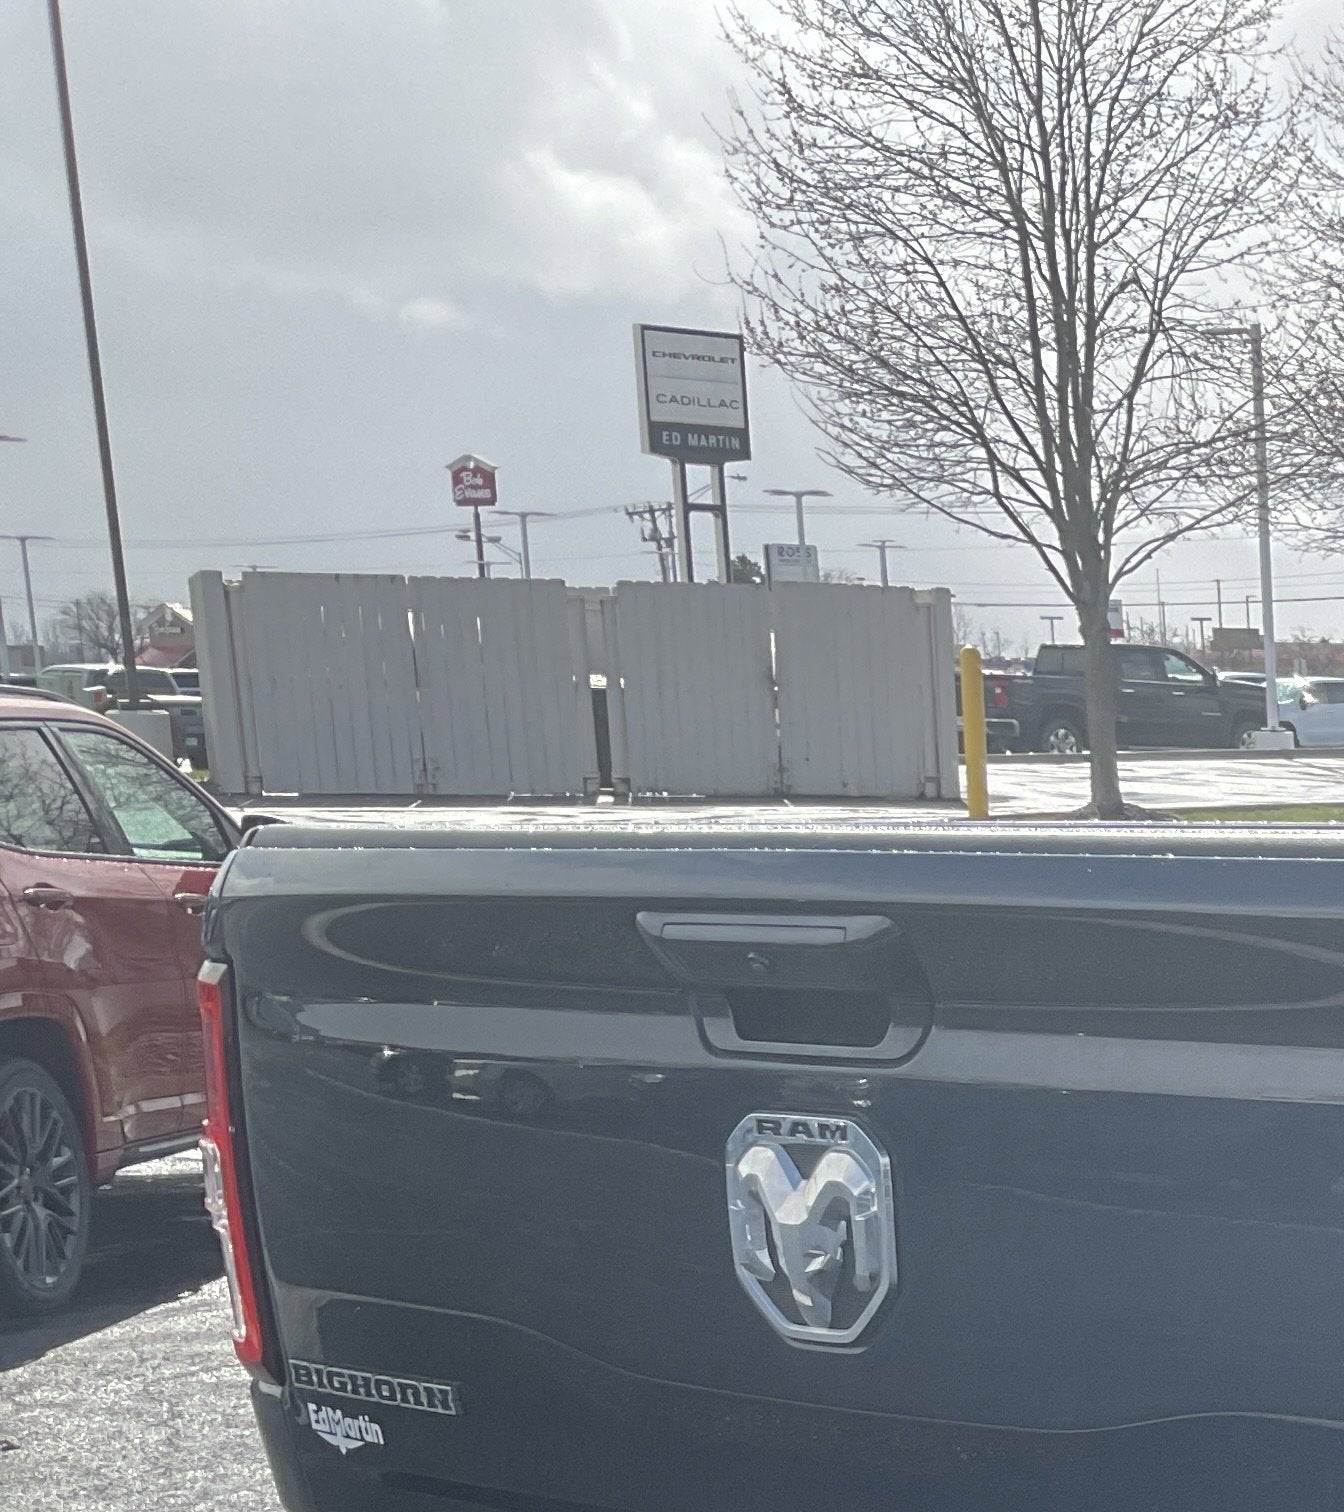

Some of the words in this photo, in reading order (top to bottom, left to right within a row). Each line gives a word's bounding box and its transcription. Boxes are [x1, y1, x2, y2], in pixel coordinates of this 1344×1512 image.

[652, 350, 738, 365] CHEVROLET
[655, 393, 741, 410] CADILLAC
[662, 431, 681, 446] ED
[687, 433, 741, 450] MARTIN
[460, 471, 483, 486] Bob
[755, 1118, 849, 1143] RAM
[289, 1359, 457, 1416] BIGHORN
